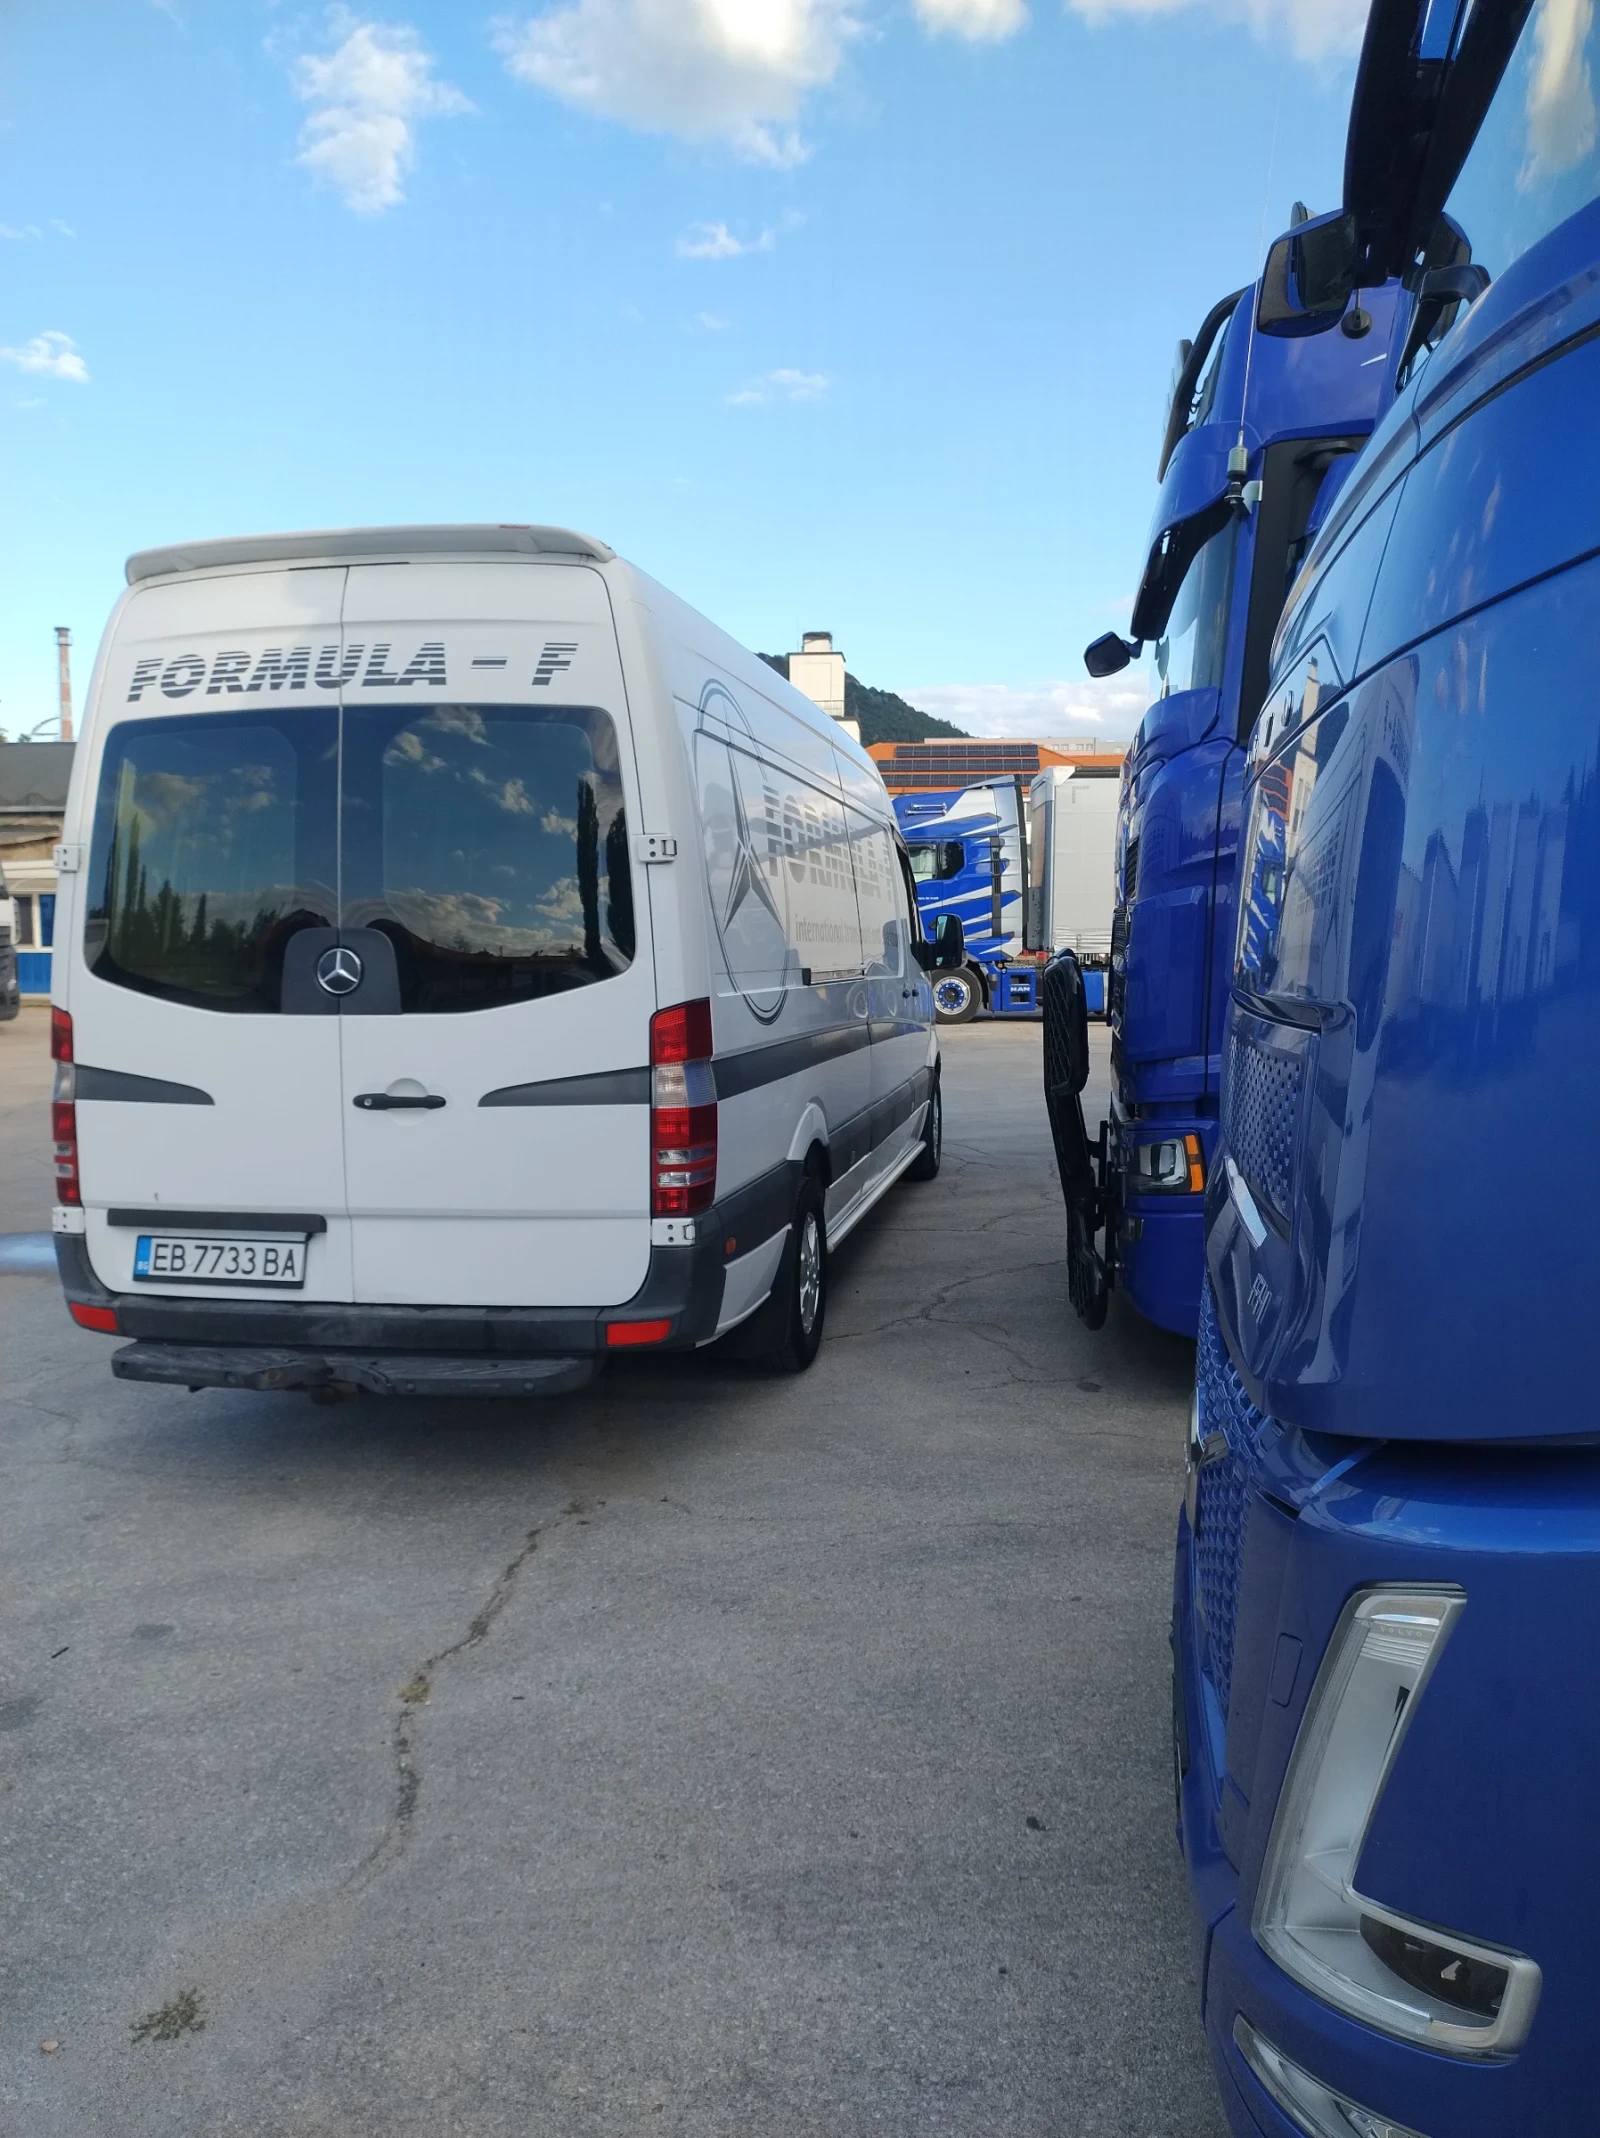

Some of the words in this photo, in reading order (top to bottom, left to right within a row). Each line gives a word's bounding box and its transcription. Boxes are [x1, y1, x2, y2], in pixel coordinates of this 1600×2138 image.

[126, 642, 447, 702] FORMULA
[531, 642, 579, 686] F
[137, 1260, 149, 1270] BG
[153, 1243, 186, 1272] EB
[193, 1244, 256, 1275] 7733
[263, 1248, 296, 1277] BA
